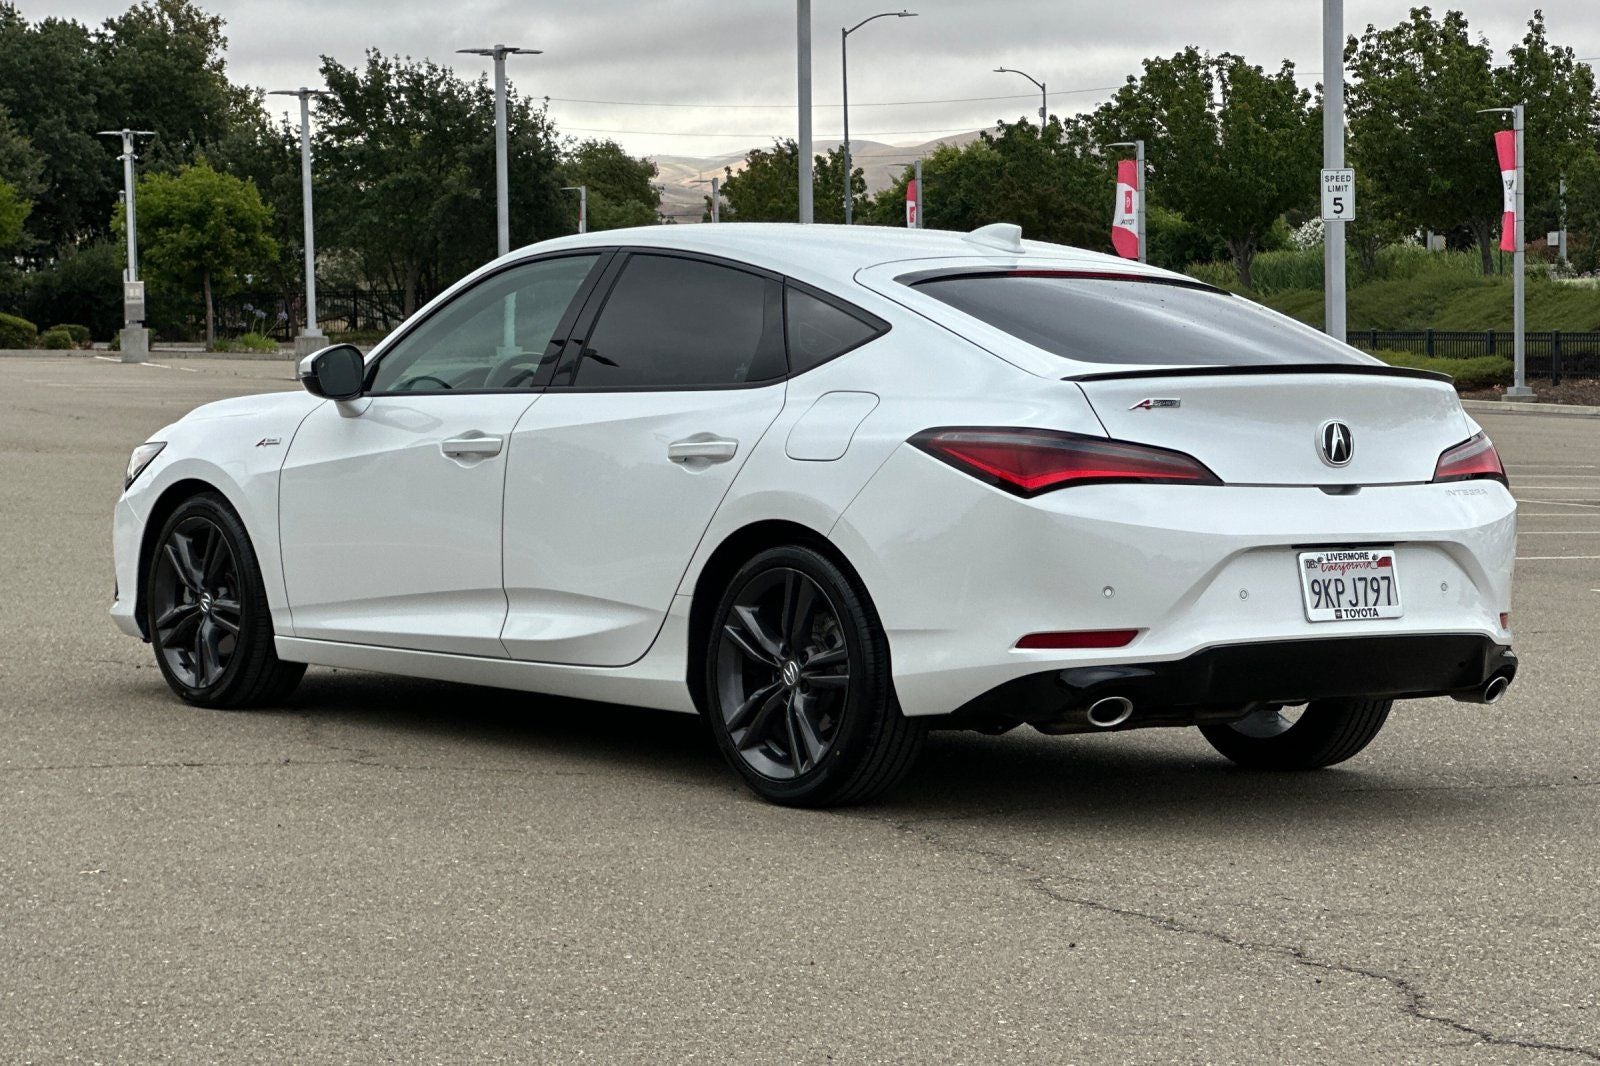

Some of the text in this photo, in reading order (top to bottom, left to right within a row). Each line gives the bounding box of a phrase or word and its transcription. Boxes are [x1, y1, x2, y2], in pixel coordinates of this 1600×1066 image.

[1333, 197, 1344, 214] 5
[1326, 552, 1369, 561] LIVERMORE
[1311, 576, 1391, 609] 9KPJ797
[1344, 608, 1379, 618] TOYOTA
